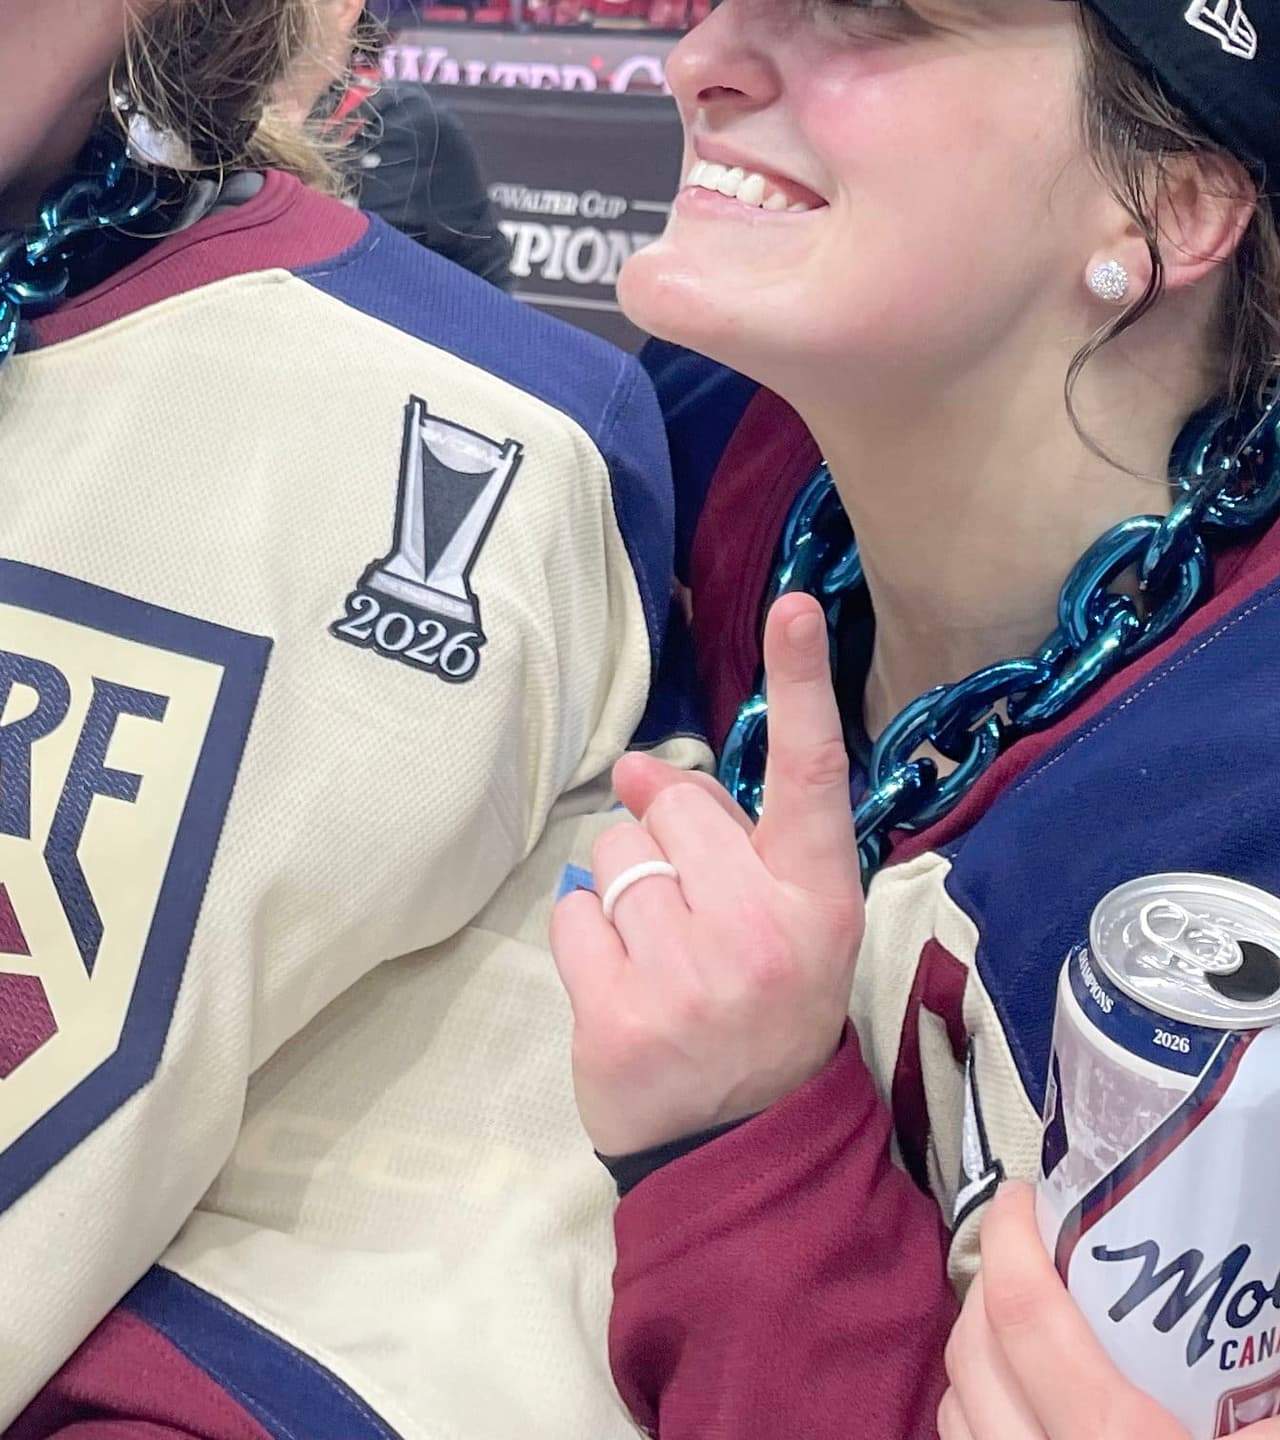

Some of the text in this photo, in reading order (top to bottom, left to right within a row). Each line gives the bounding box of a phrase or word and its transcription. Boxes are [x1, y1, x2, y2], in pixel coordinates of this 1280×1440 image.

[488, 183, 628, 219] WALTER CUP
[337, 593, 479, 676] 2026
[1077, 948, 1114, 1013] CHAMPIONS
[1152, 1028, 1190, 1054] 2026
